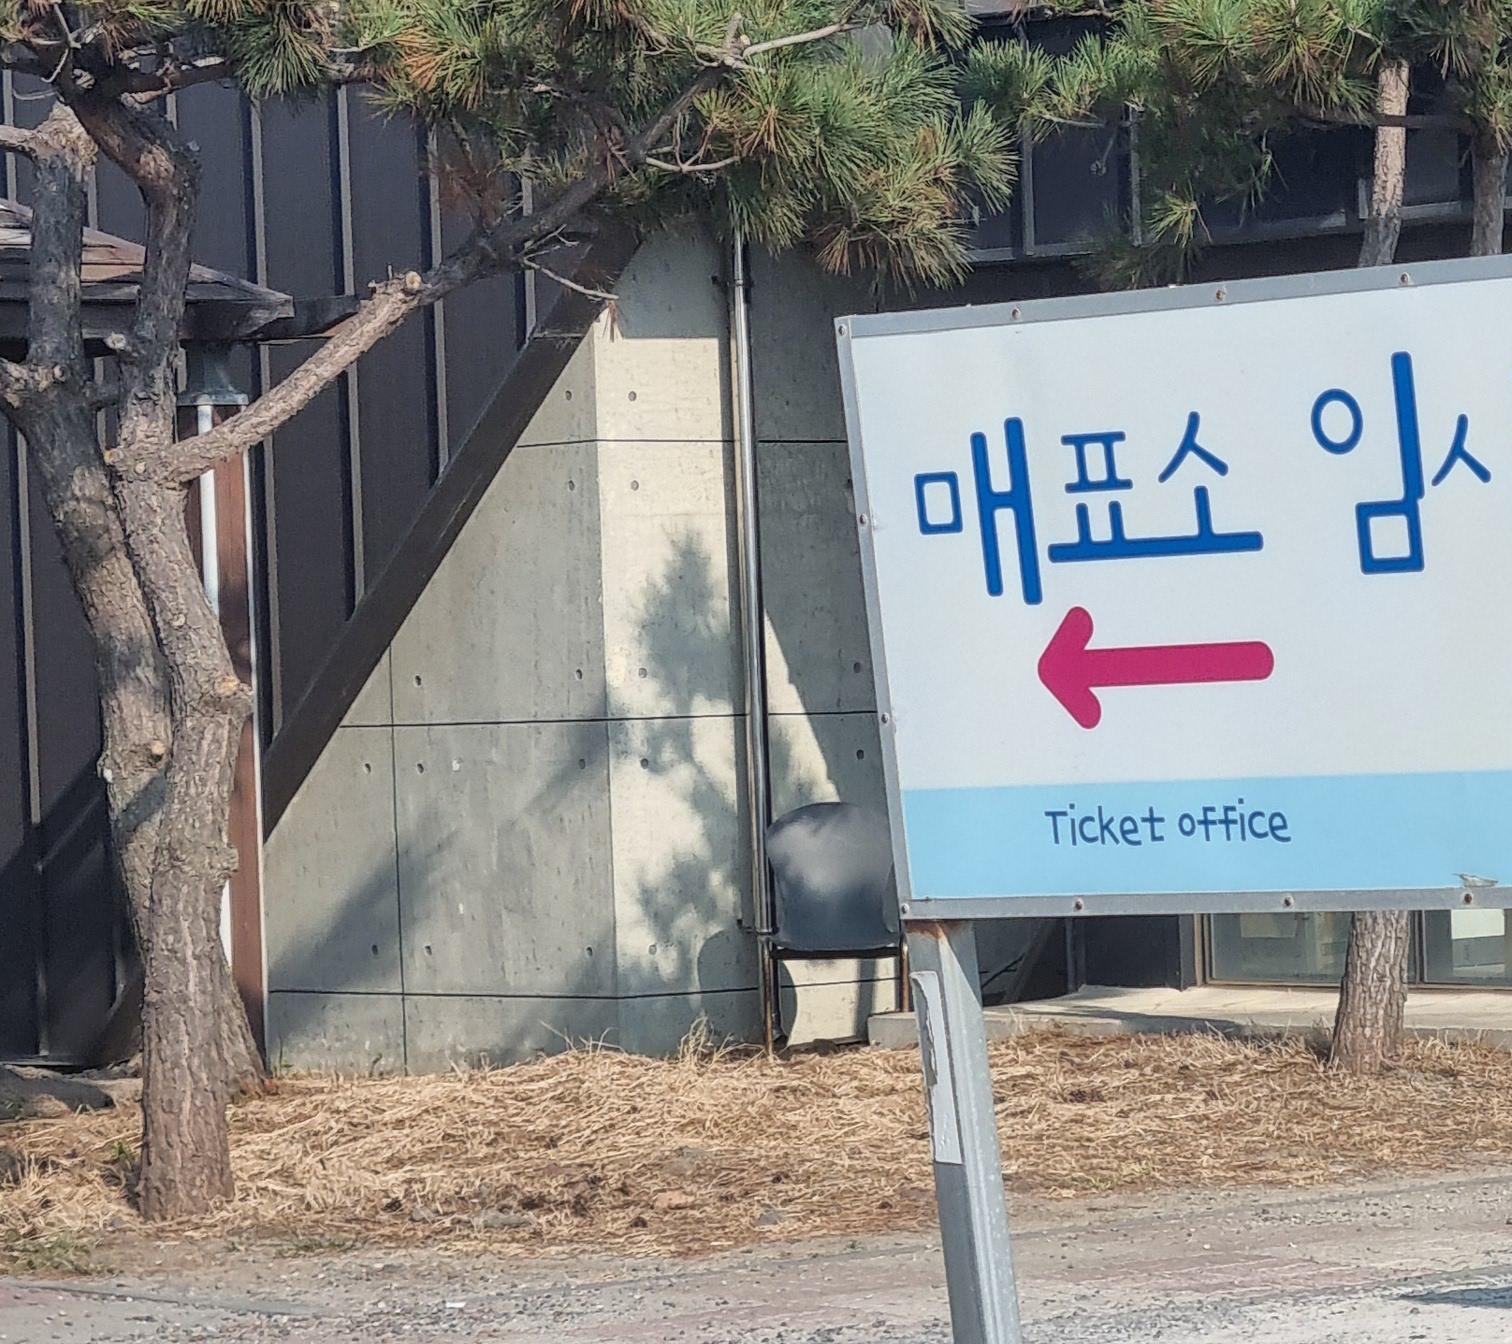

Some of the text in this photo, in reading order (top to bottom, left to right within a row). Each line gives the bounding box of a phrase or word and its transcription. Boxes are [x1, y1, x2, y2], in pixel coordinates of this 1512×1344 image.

[913, 410, 1264, 605] 매표소
[1044, 804, 1292, 847] Ticket office
